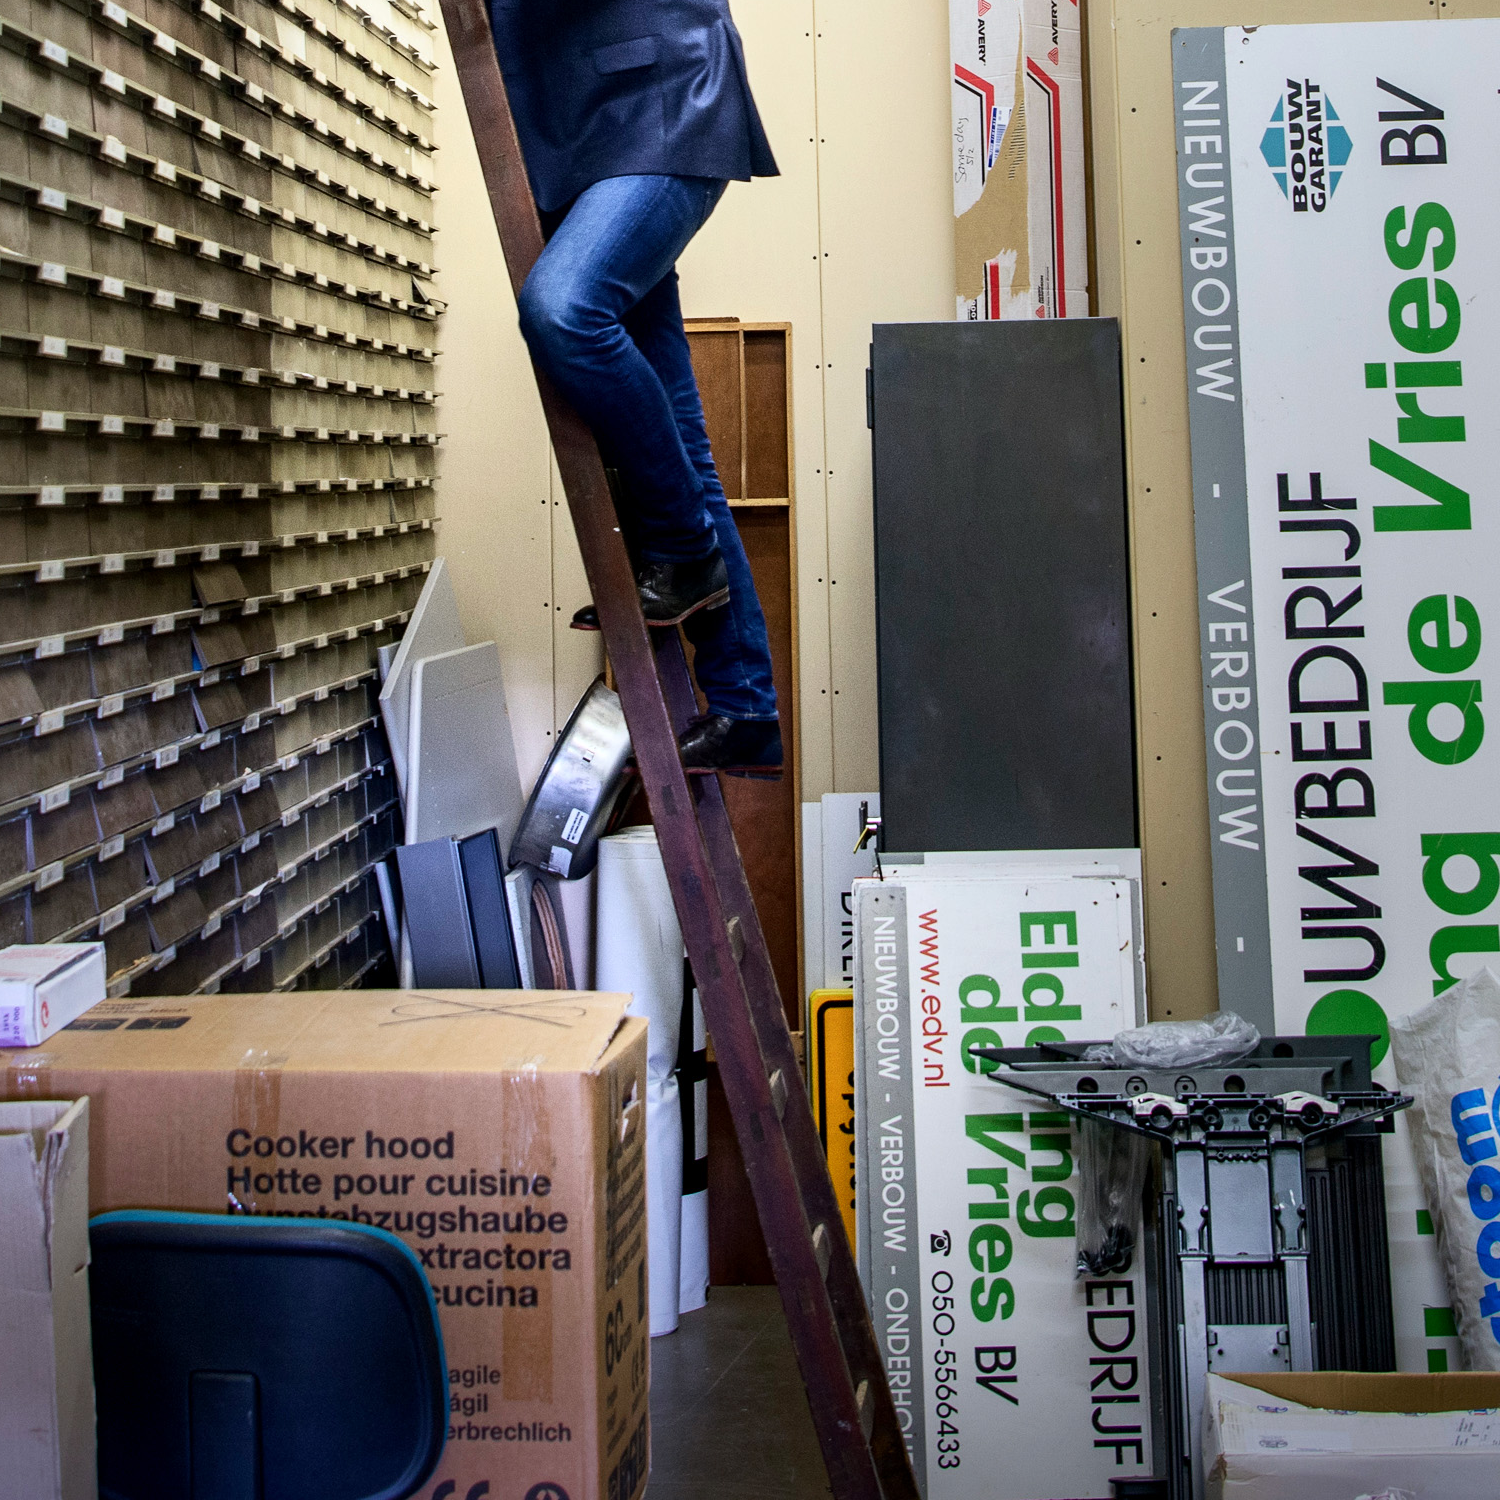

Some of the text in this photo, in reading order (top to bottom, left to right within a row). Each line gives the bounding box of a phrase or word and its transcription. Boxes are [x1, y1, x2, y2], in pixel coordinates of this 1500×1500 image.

[977, 18, 987, 64] AVERY
[1049, 0, 1059, 46] AVERY
[1286, 77, 1309, 213] BOUW
[1304, 77, 1328, 214] GARANT
[1376, 76, 1449, 166] BV
[1364, 201, 1472, 533] Vries
[1181, 80, 1260, 851] NIEUWBOUW VERBOUW
[1381, 593, 1485, 765] de
[918, 908, 951, 1088] www.edv.nl
[225, 1128, 455, 1160] Cooker hood
[226, 1165, 552, 1200] Hotte pour cuisine
[873, 915, 914, 1465] NIEUWBOUW VERBOUW ONDERHO
[417, 1243, 572, 1271] xtractora
[964, 1111, 1028, 1323] Vries
[448, 1365, 501, 1389] agile
[930, 1270, 961, 1470] 050-5566433
[973, 1345, 1020, 1406] BV
[445, 1422, 572, 1443] erbrechlich
